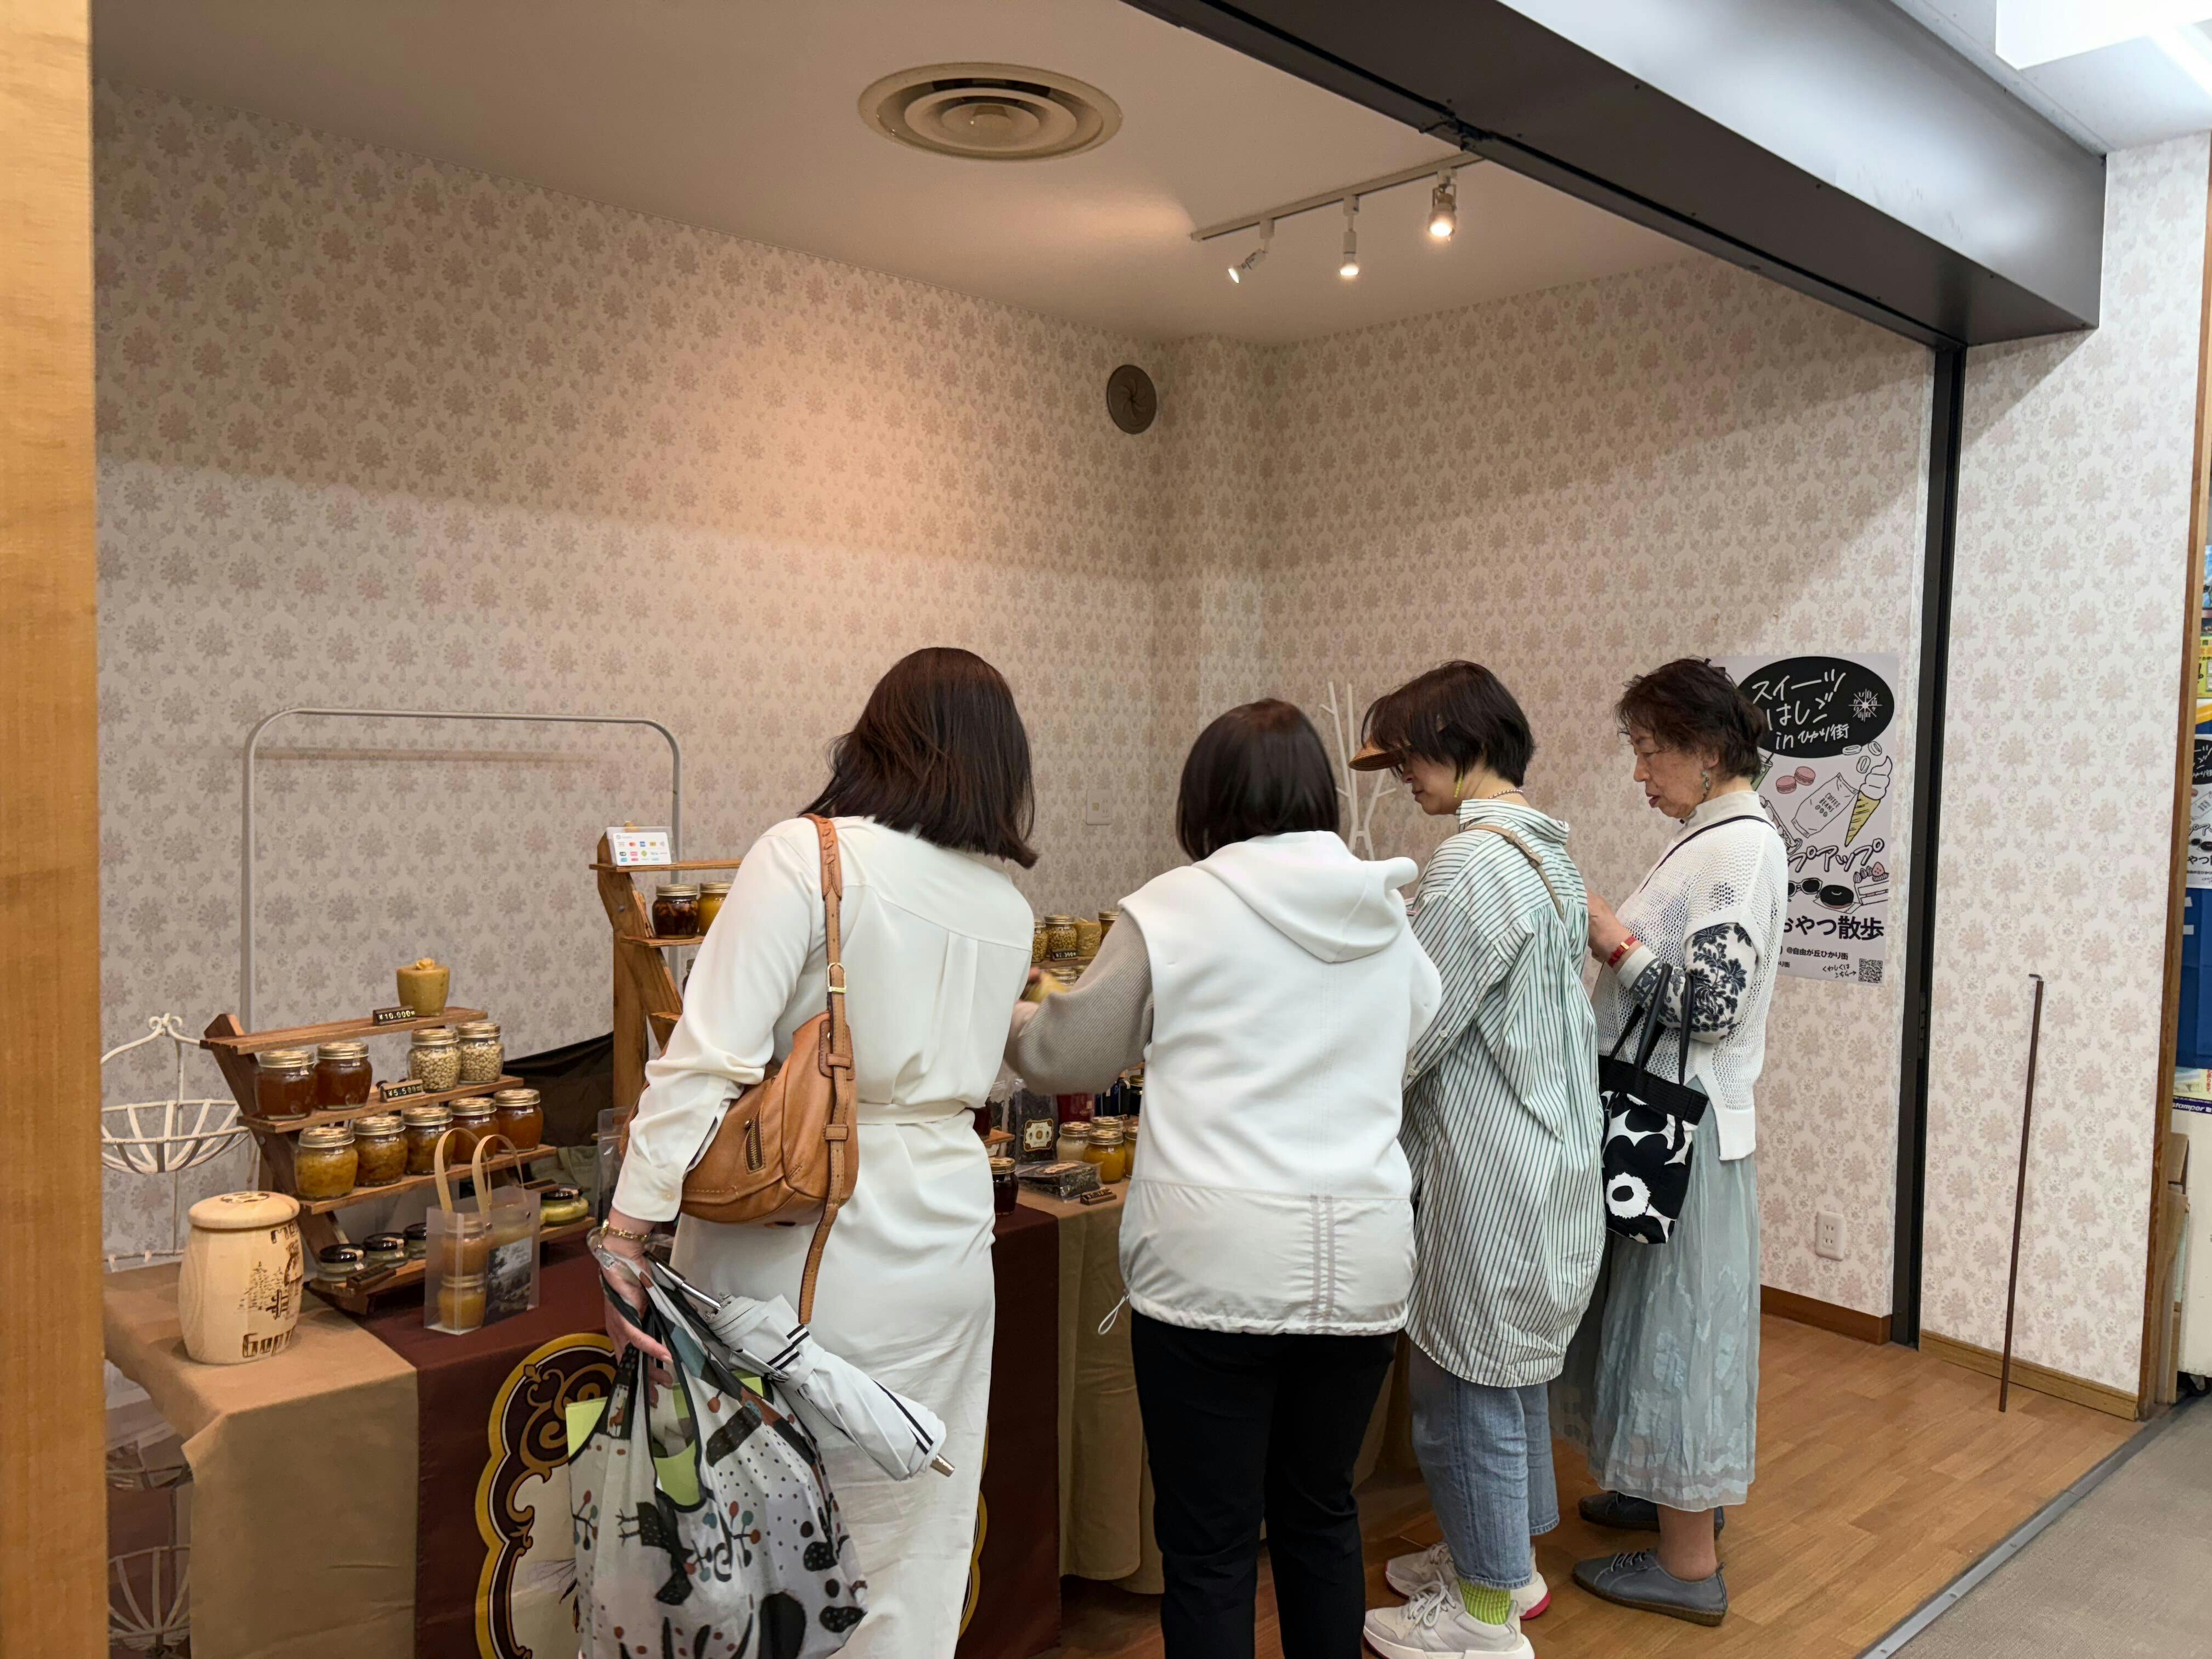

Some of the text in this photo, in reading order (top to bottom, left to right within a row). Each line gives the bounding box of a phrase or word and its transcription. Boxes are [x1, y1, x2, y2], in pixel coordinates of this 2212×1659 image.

[1752, 668, 1847, 704] スイーツ
[1767, 691, 1834, 731] はしご
[1776, 723, 1849, 751] in ひかり街
[1819, 798, 1835, 812] BEANS
[1825, 792, 1841, 808] COFFEE
[1787, 838, 1885, 873] プアップ
[1786, 946, 1848, 960] @自由が丘ひかり街
[1822, 963, 1850, 972] くわしくは
